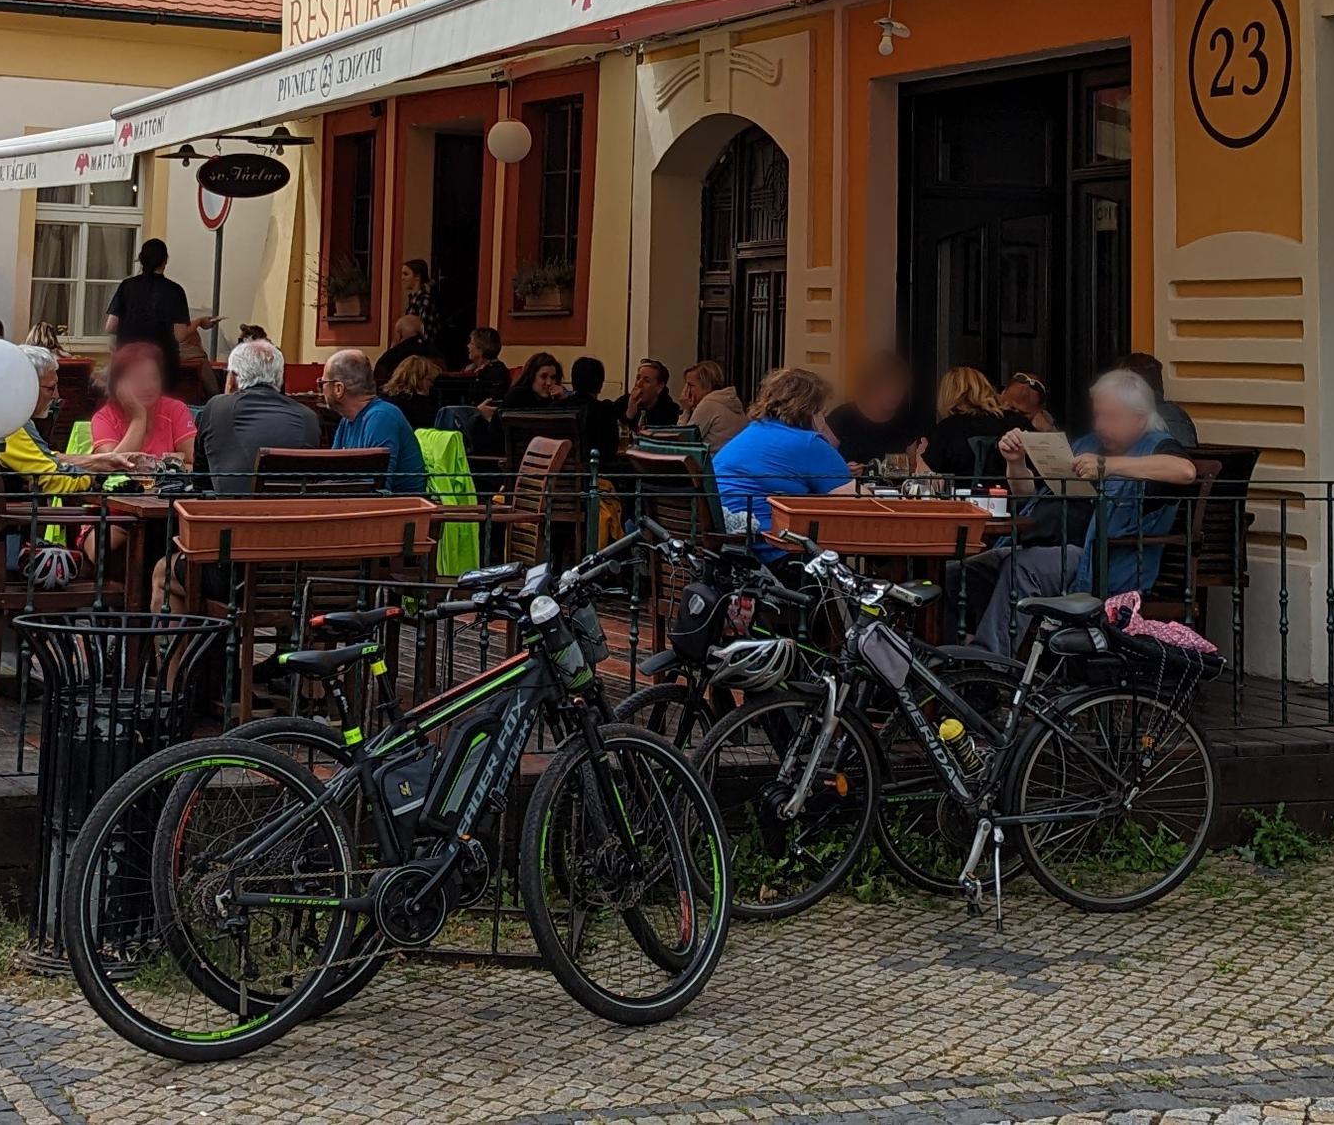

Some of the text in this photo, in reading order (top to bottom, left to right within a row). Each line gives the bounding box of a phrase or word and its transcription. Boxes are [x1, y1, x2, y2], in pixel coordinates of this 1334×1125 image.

[277, 67, 318, 102] PIVNICE
[1209, 19, 1270, 99] 23
[133, 117, 166, 140] MATTONI
[6, 160, 37, 182] VÁCLAVA
[90, 153, 127, 171] MATTONI
[496, 719, 531, 795] EADER
[898, 687, 956, 781] MERIDA
[457, 689, 527, 836] EADER FOX
